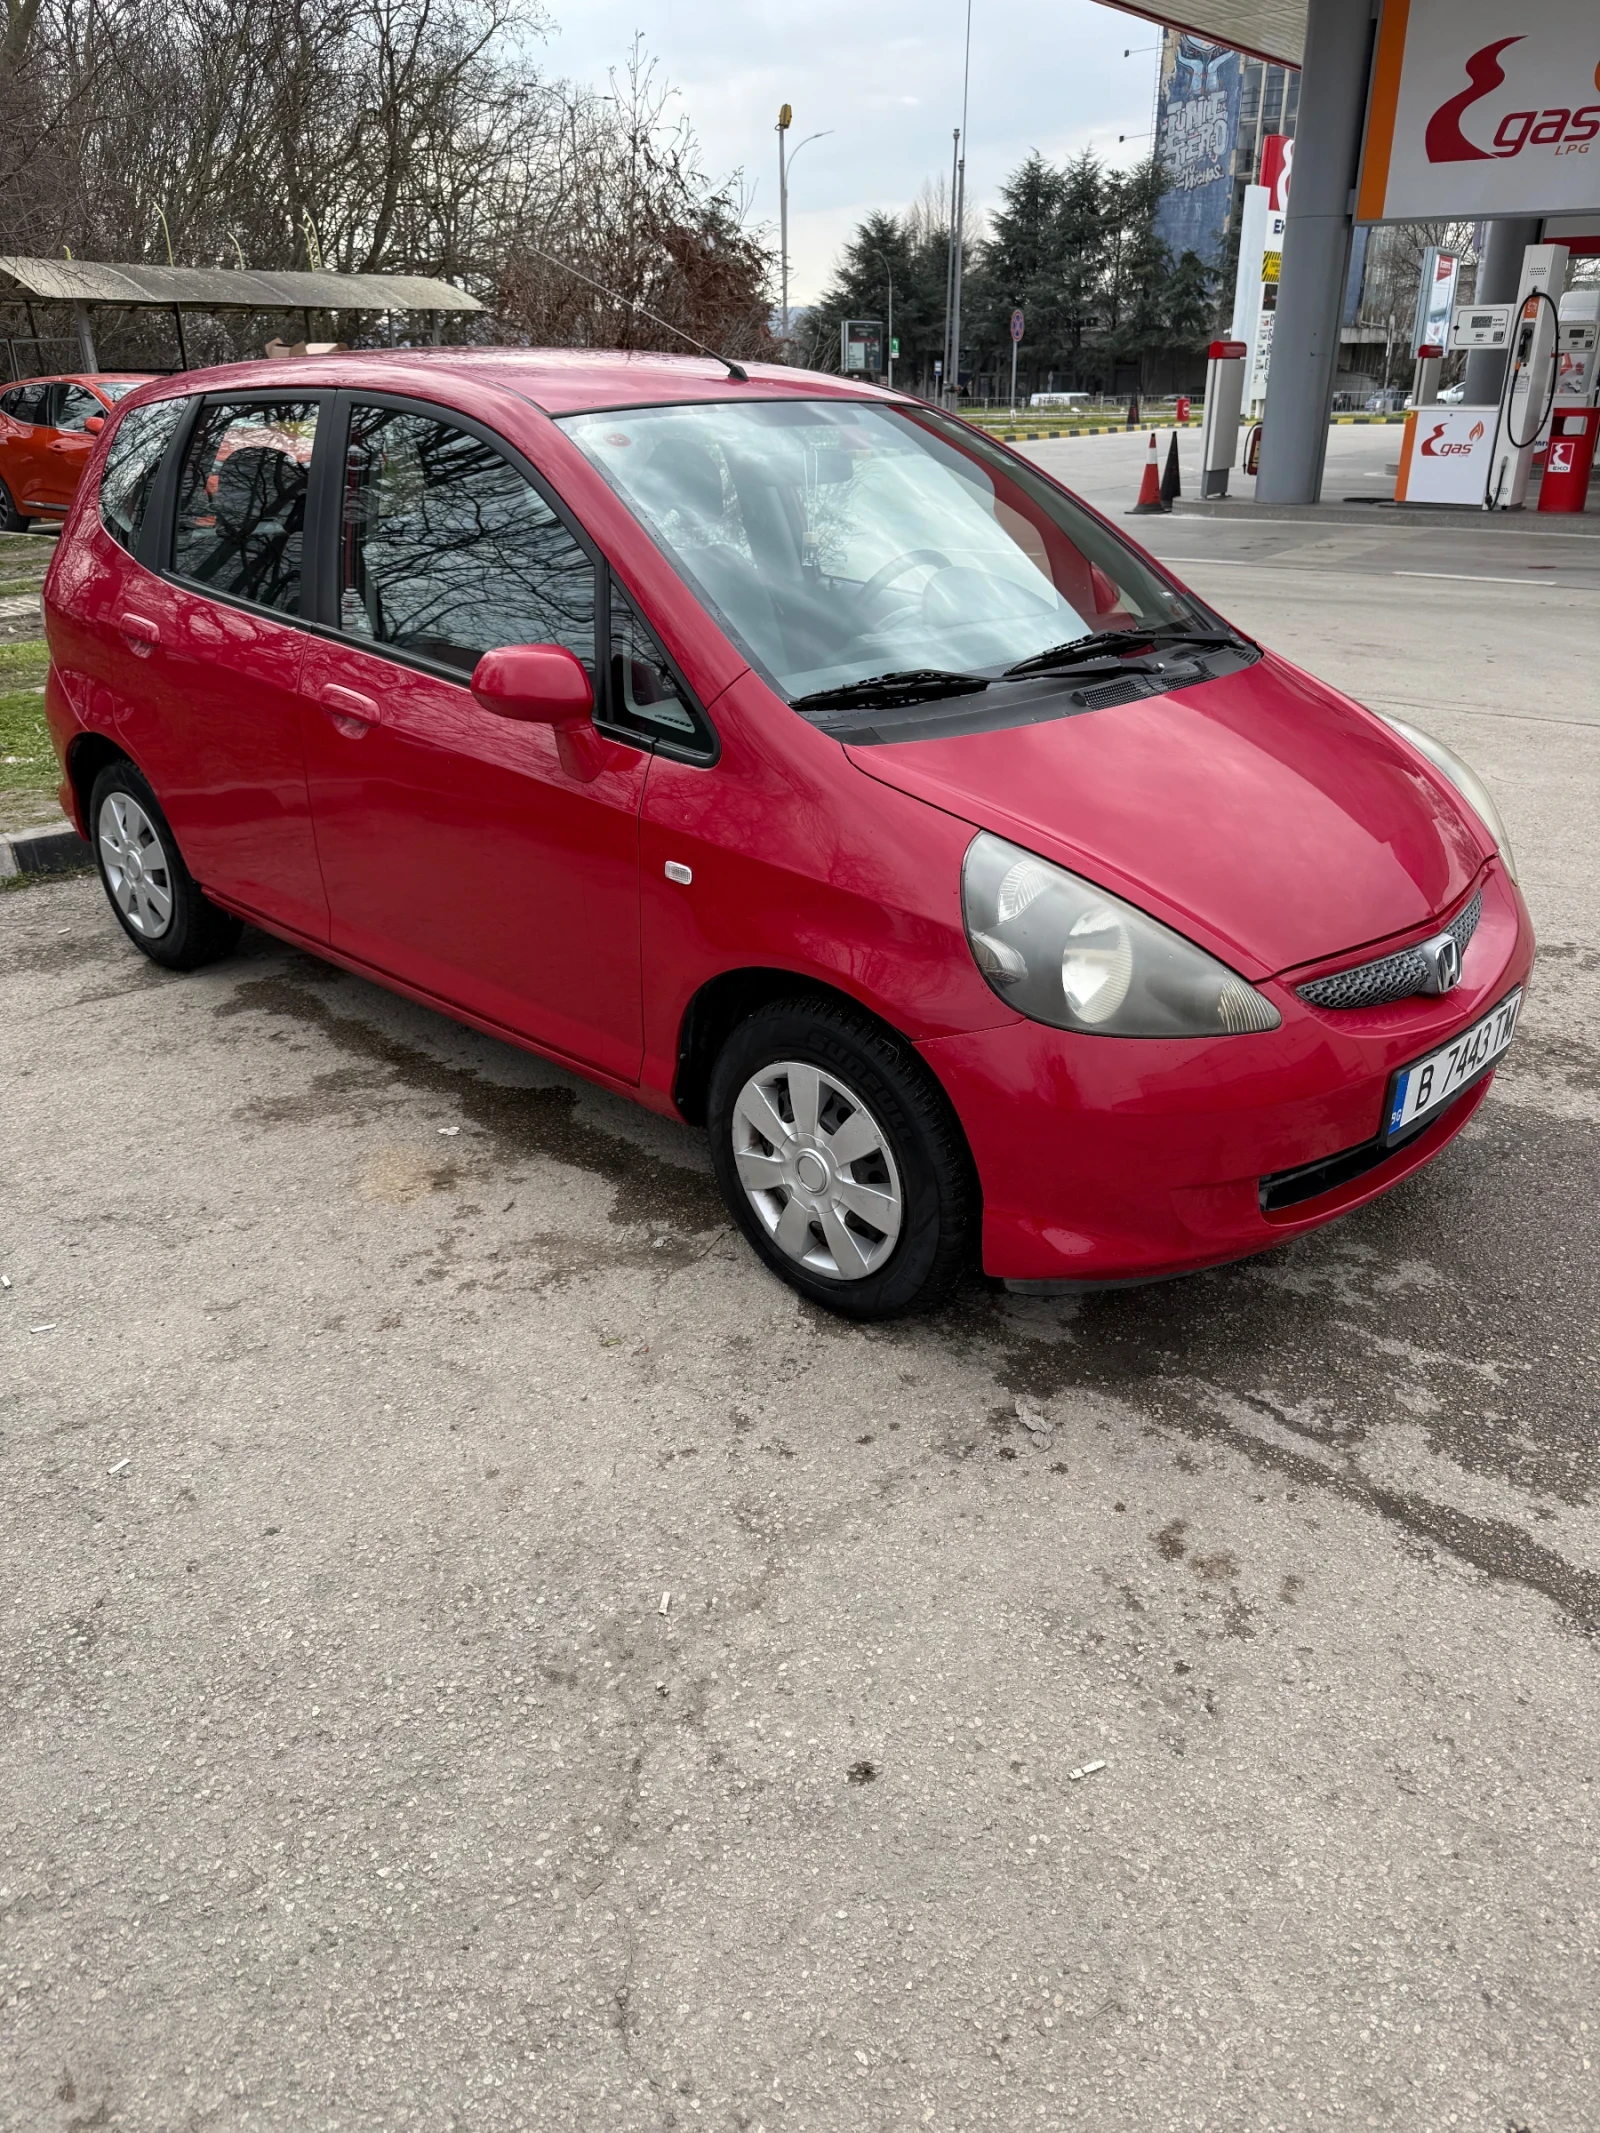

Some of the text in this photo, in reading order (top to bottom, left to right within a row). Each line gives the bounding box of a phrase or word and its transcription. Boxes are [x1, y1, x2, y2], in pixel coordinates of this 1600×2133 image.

[1554, 143, 1591, 156] LPG
[1415, 1064, 1434, 1112] B
[1440, 1022, 1492, 1095] 7443
